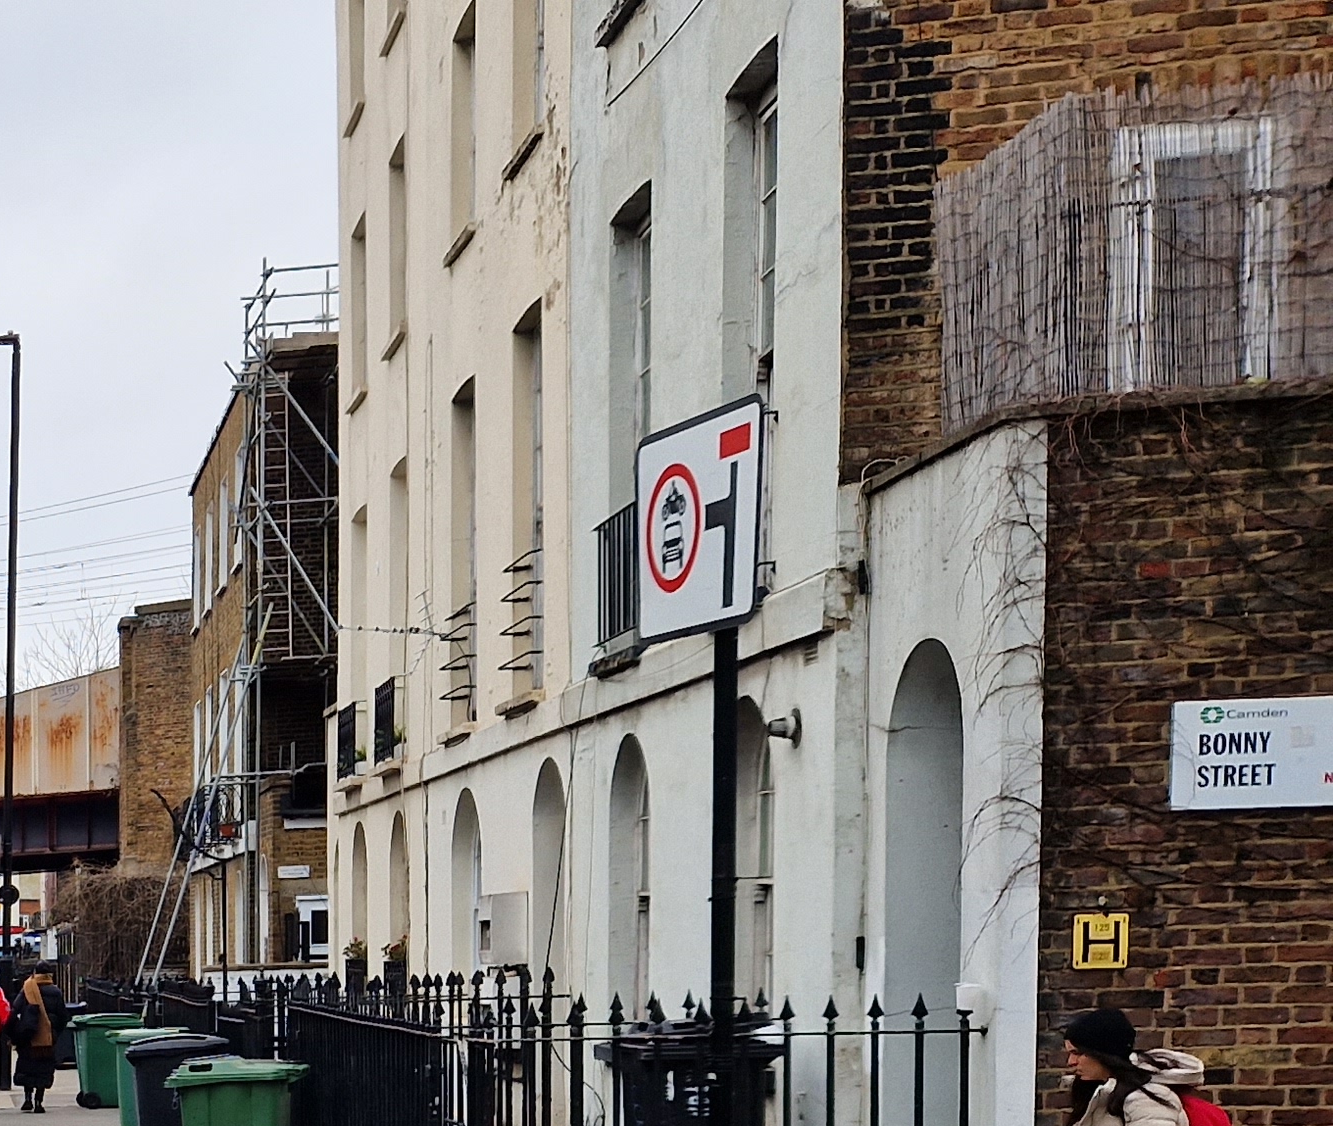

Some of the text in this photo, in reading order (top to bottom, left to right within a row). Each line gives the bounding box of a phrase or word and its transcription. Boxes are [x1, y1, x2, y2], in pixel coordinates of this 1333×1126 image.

[1226, 708, 1289, 720] Camden
[1198, 731, 1272, 756] BONNY
[1197, 763, 1277, 788] STREET
[1082, 920, 1120, 963] H
